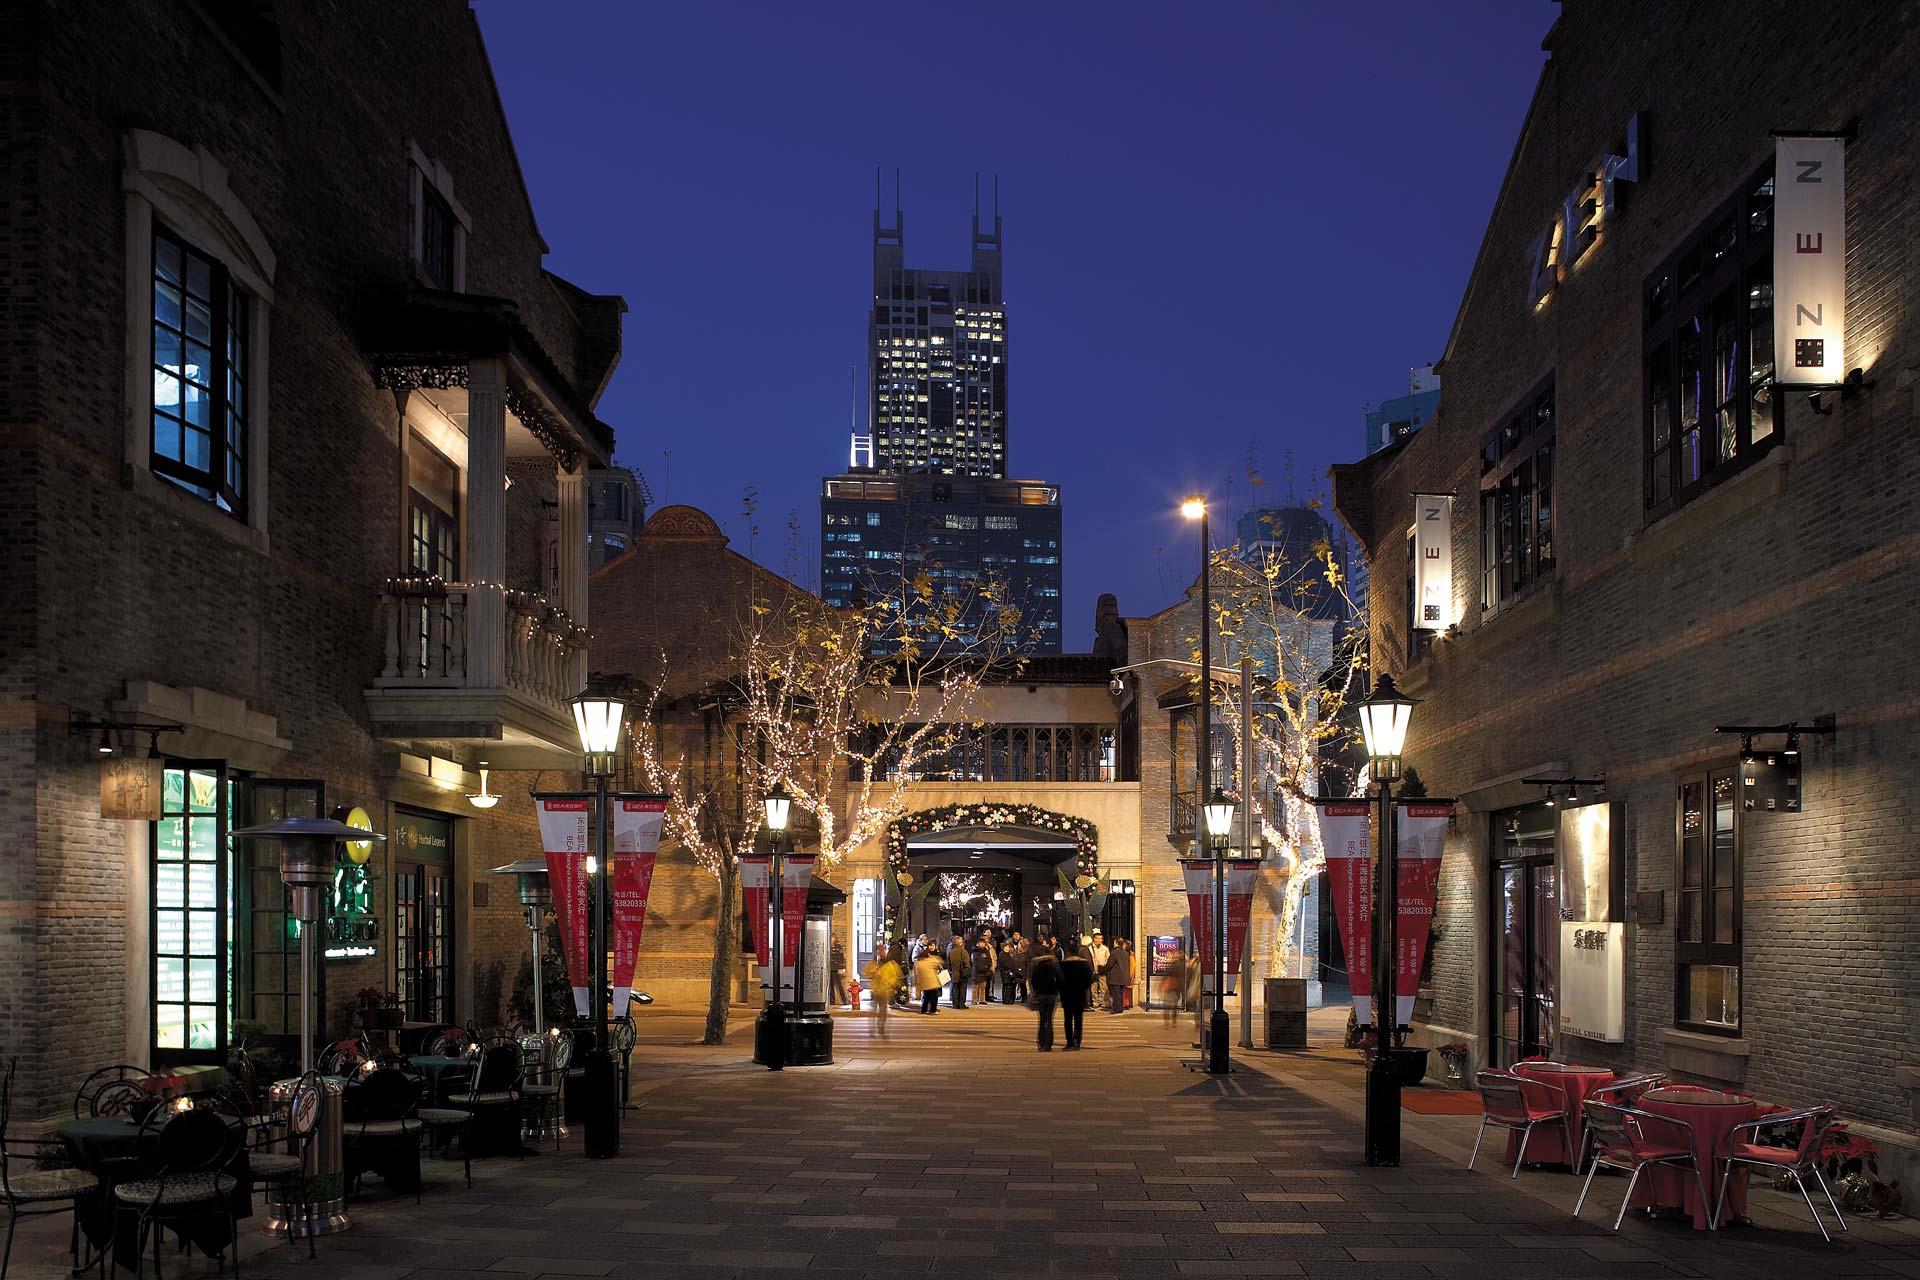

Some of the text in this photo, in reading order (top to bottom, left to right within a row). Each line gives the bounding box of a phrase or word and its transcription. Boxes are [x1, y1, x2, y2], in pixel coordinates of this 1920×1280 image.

[1796, 161, 1822, 326] ZEN
[1425, 508, 1440, 598] ZEN
[418, 834, 431, 845] Herbal
[432, 835, 446, 847] Legend
